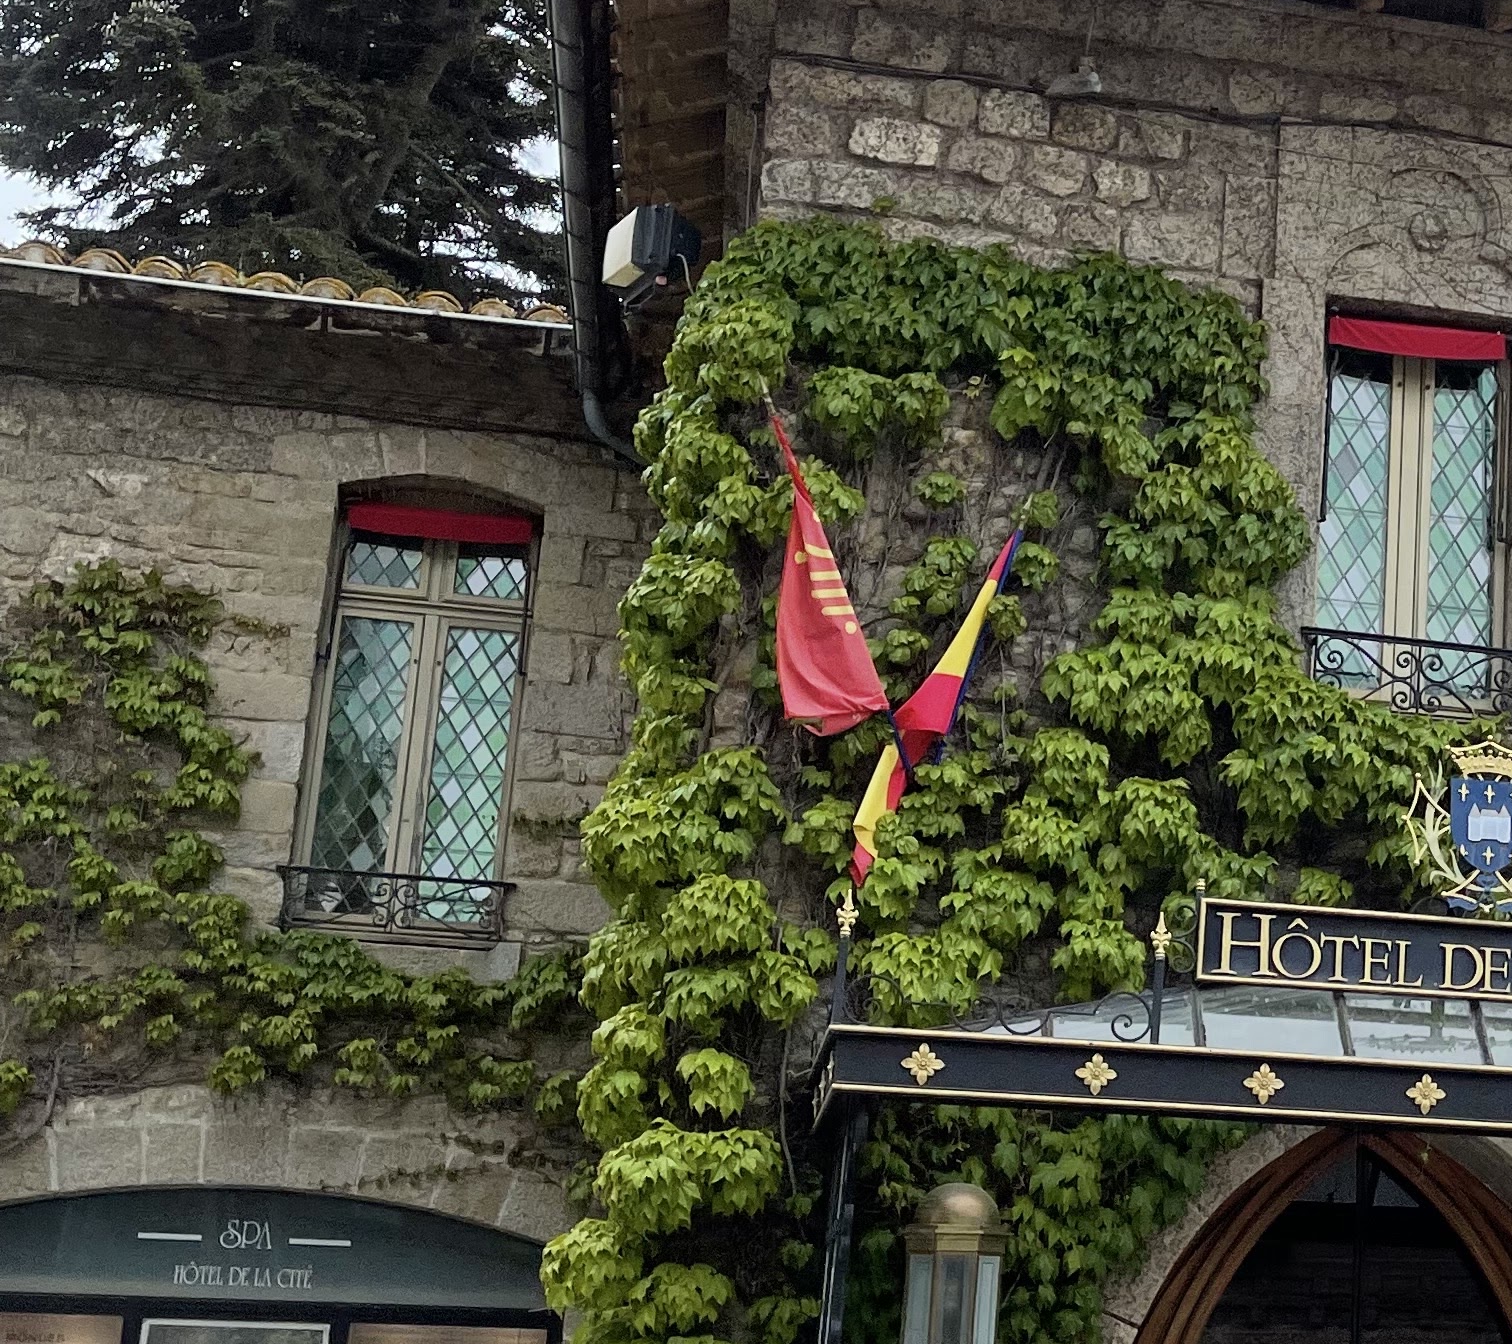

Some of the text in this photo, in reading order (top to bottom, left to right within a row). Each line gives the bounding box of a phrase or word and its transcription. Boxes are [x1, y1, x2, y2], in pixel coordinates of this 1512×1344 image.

[1210, 911, 1424, 988] HÔTEL
[1438, 941, 1512, 994] DE
[219, 1219, 272, 1250] SPA
[173, 1261, 223, 1286] HÔTEL
[228, 1266, 250, 1287] DE
[254, 1267, 272, 1288] LA
